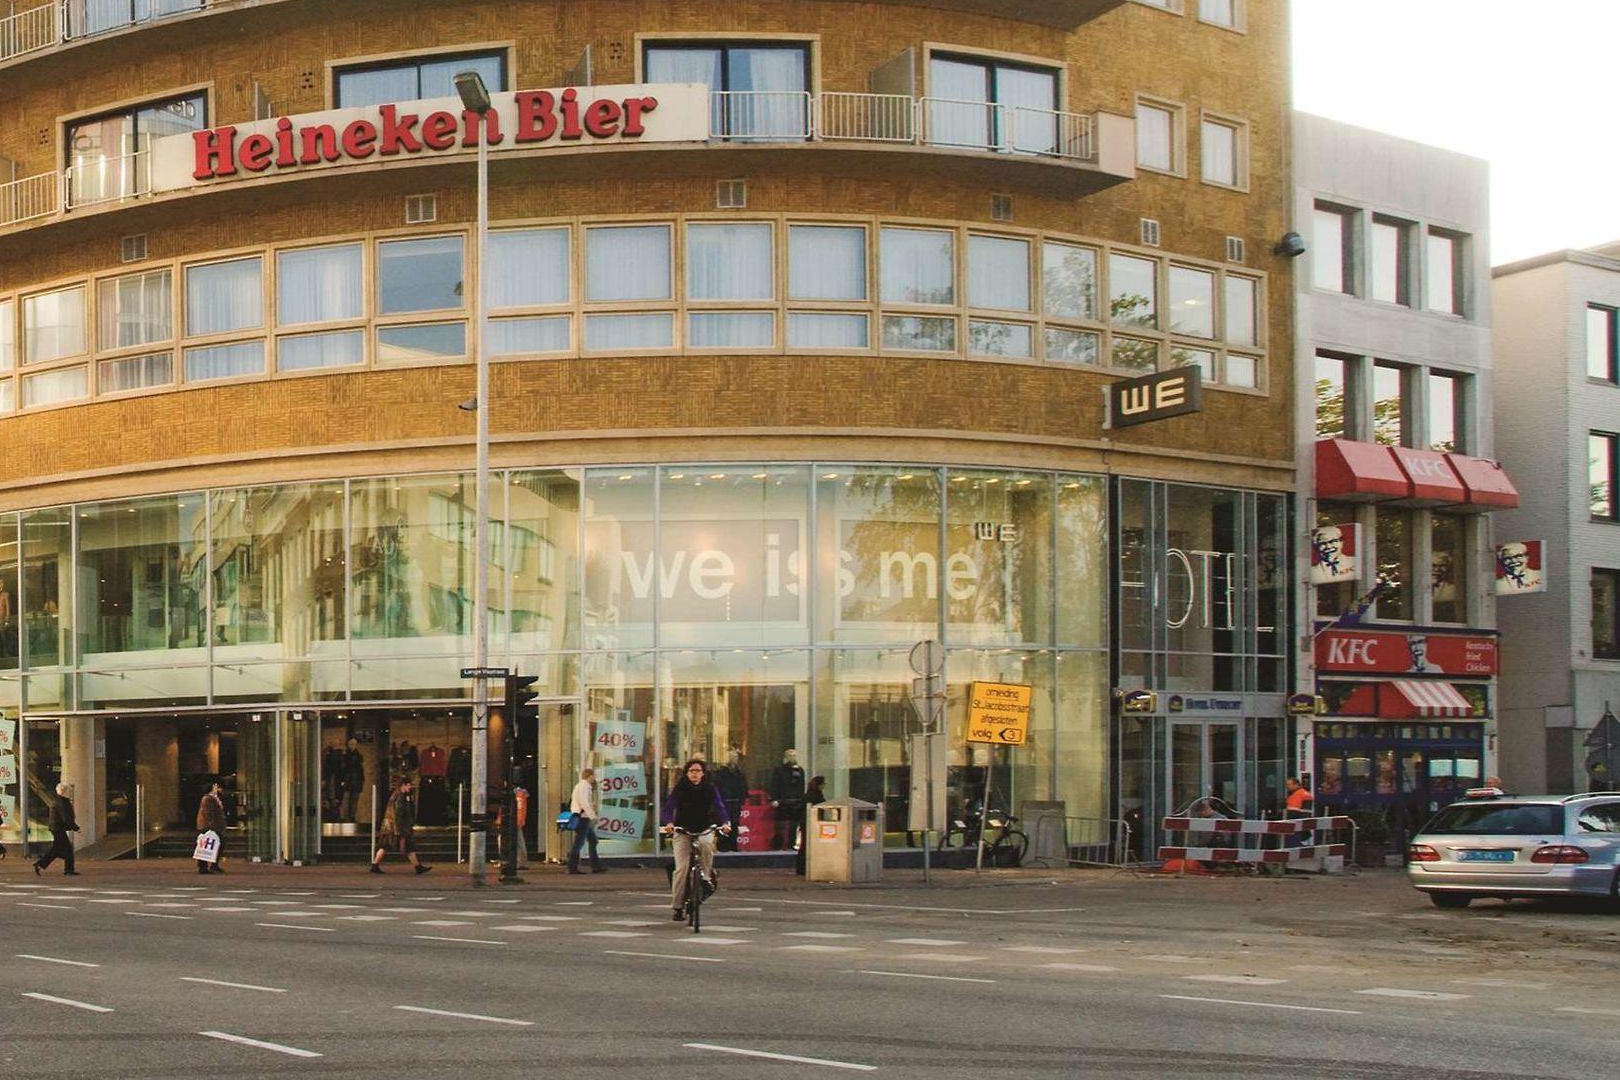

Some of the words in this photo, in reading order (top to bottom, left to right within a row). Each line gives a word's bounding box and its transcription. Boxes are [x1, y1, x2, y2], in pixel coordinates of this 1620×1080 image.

[191, 104, 504, 181] Heineken
[515, 88, 659, 143] Bier
[1121, 376, 1185, 415] WE
[1405, 457, 1452, 479] KFC
[620, 547, 735, 600] we
[880, 547, 982, 601] me
[1327, 637, 1378, 665] KFC
[598, 732, 636, 748] 40%
[972, 729, 993, 741] volg
[601, 775, 639, 792] 30%
[597, 817, 636, 835] 20%
